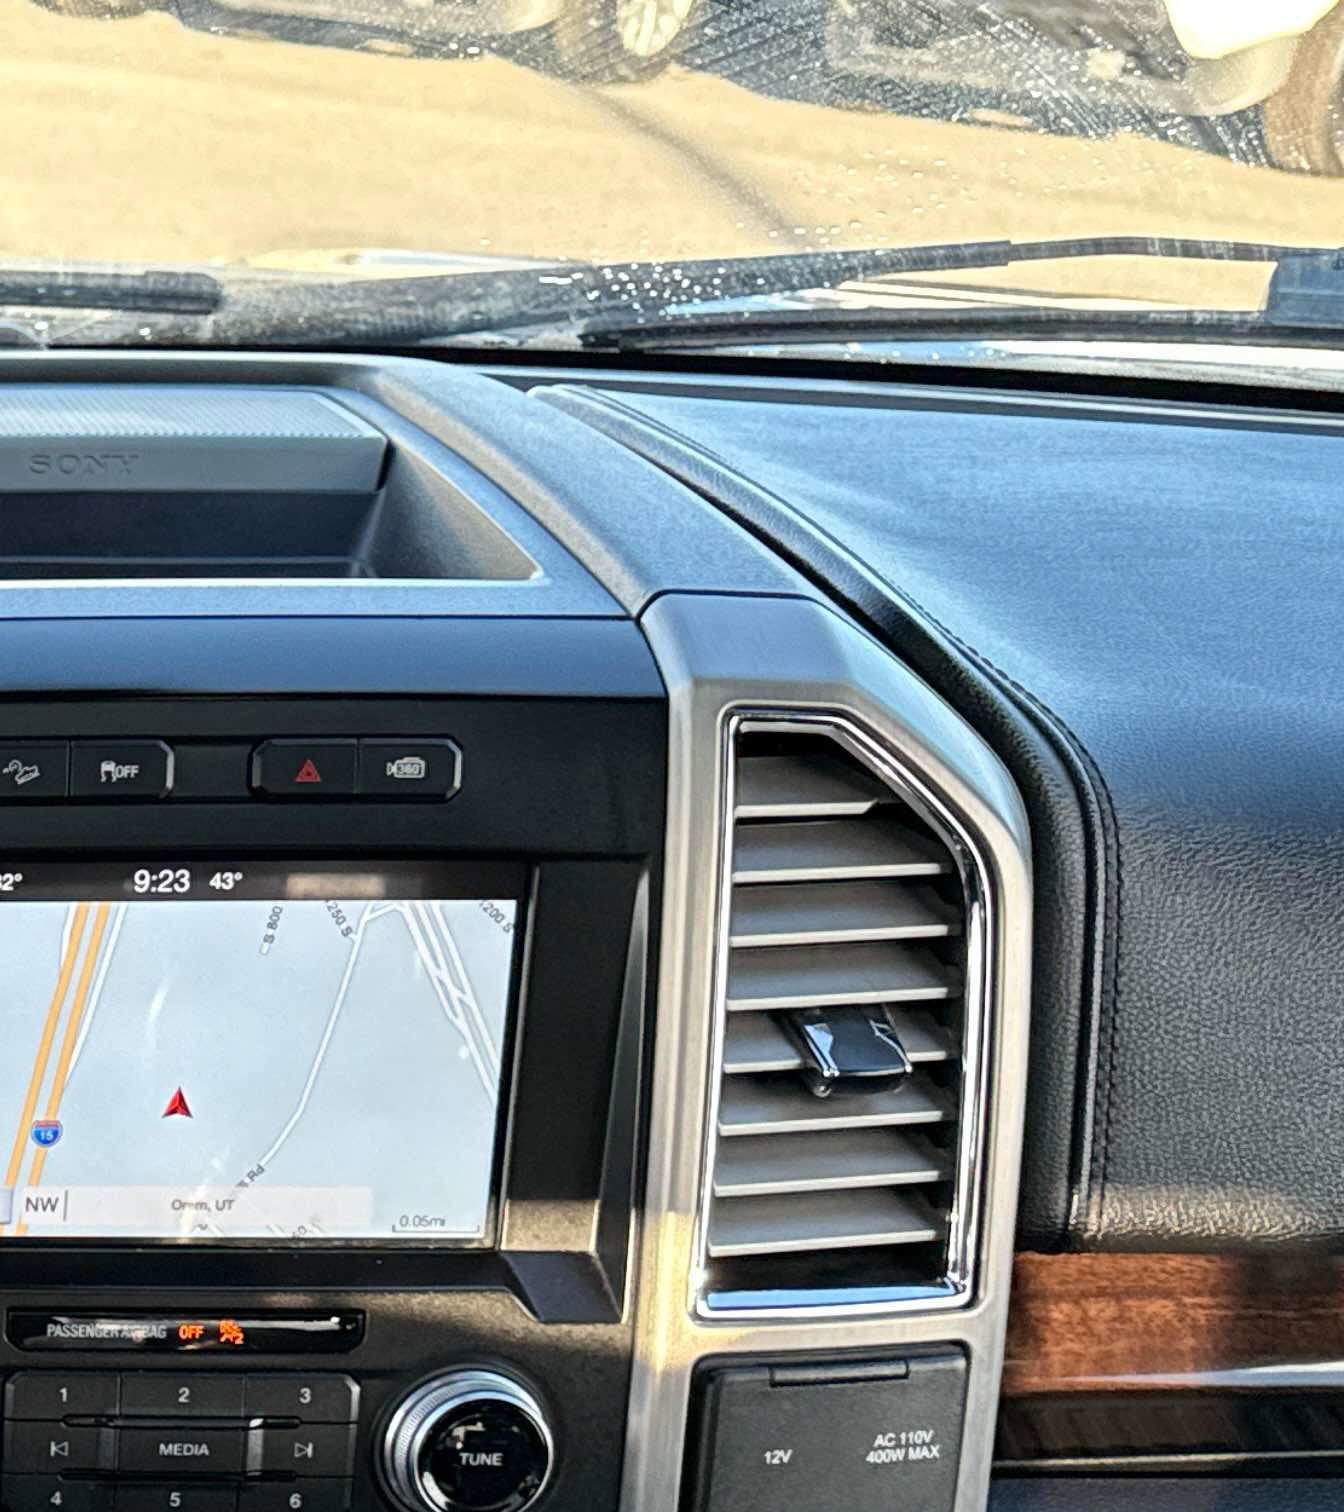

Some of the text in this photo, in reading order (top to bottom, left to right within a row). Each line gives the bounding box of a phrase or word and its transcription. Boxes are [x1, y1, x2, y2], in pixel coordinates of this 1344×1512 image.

[28, 453, 141, 475] SONY
[115, 764, 140, 779] OFF
[133, 869, 191, 893] 9:23
[209, 871, 243, 890] 43°
[266, 904, 283, 930] 800
[39, 1129, 54, 1141] 15
[246, 1163, 266, 1182] Rd
[25, 1197, 60, 1213] NW
[214, 1199, 234, 1212] UT
[398, 1214, 447, 1228] 0.05mi
[46, 1323, 168, 1340] PASSENGER ABAG
[178, 1324, 204, 1339] OFF
[59, 1387, 68, 1402] 1
[178, 1387, 191, 1403] 2
[299, 1387, 312, 1403] 3
[874, 1430, 934, 1448] AC 110V
[159, 1443, 210, 1457] MEDIA
[764, 1449, 792, 1465] 12V
[865, 1445, 941, 1465] 400W MAX
[459, 1452, 504, 1467] TUNE
[49, 1491, 63, 1506] 4
[169, 1491, 182, 1507] 5
[289, 1494, 303, 1509] 6
